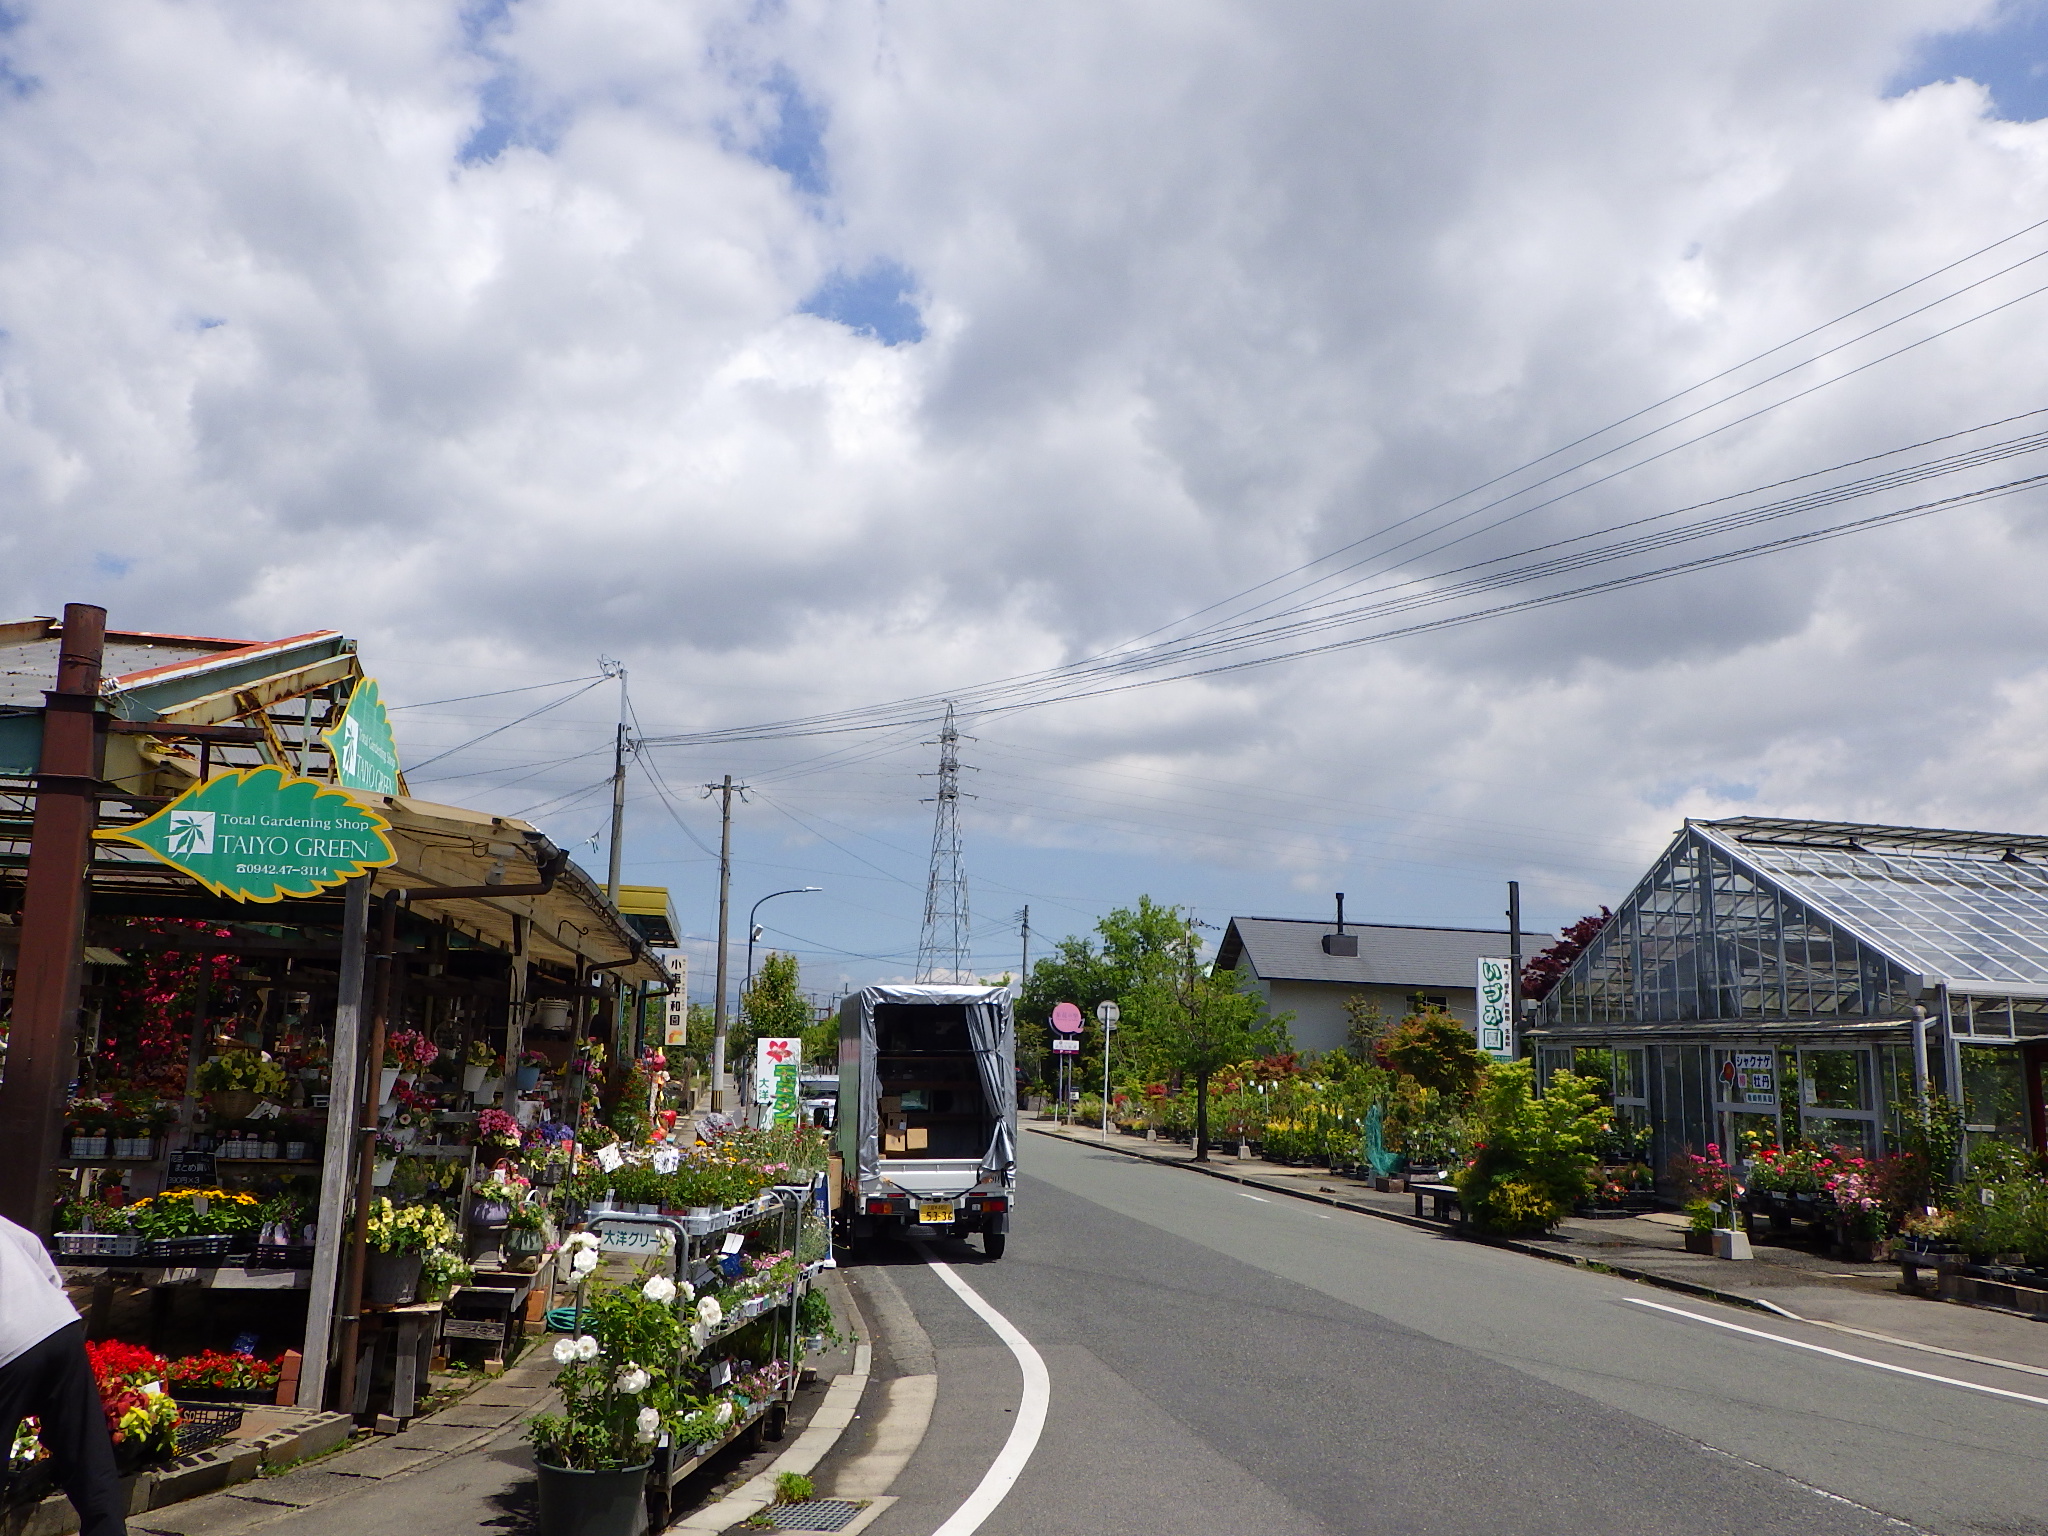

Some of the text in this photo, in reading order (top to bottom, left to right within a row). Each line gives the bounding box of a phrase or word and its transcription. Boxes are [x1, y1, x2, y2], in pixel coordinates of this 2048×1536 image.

[356, 754, 375, 788] TAIYO
[221, 813, 370, 832] Total Gardening Shop
[218, 835, 369, 859] TAIYO GREEN
[1736, 1055, 1771, 1068] シャクナゲ
[1753, 1075, 1770, 1089] 牡丹
[174, 1163, 211, 1173] まとめ買い
[926, 1211, 953, 1222] 53-36
[603, 1229, 661, 1248] 大洋グリー
